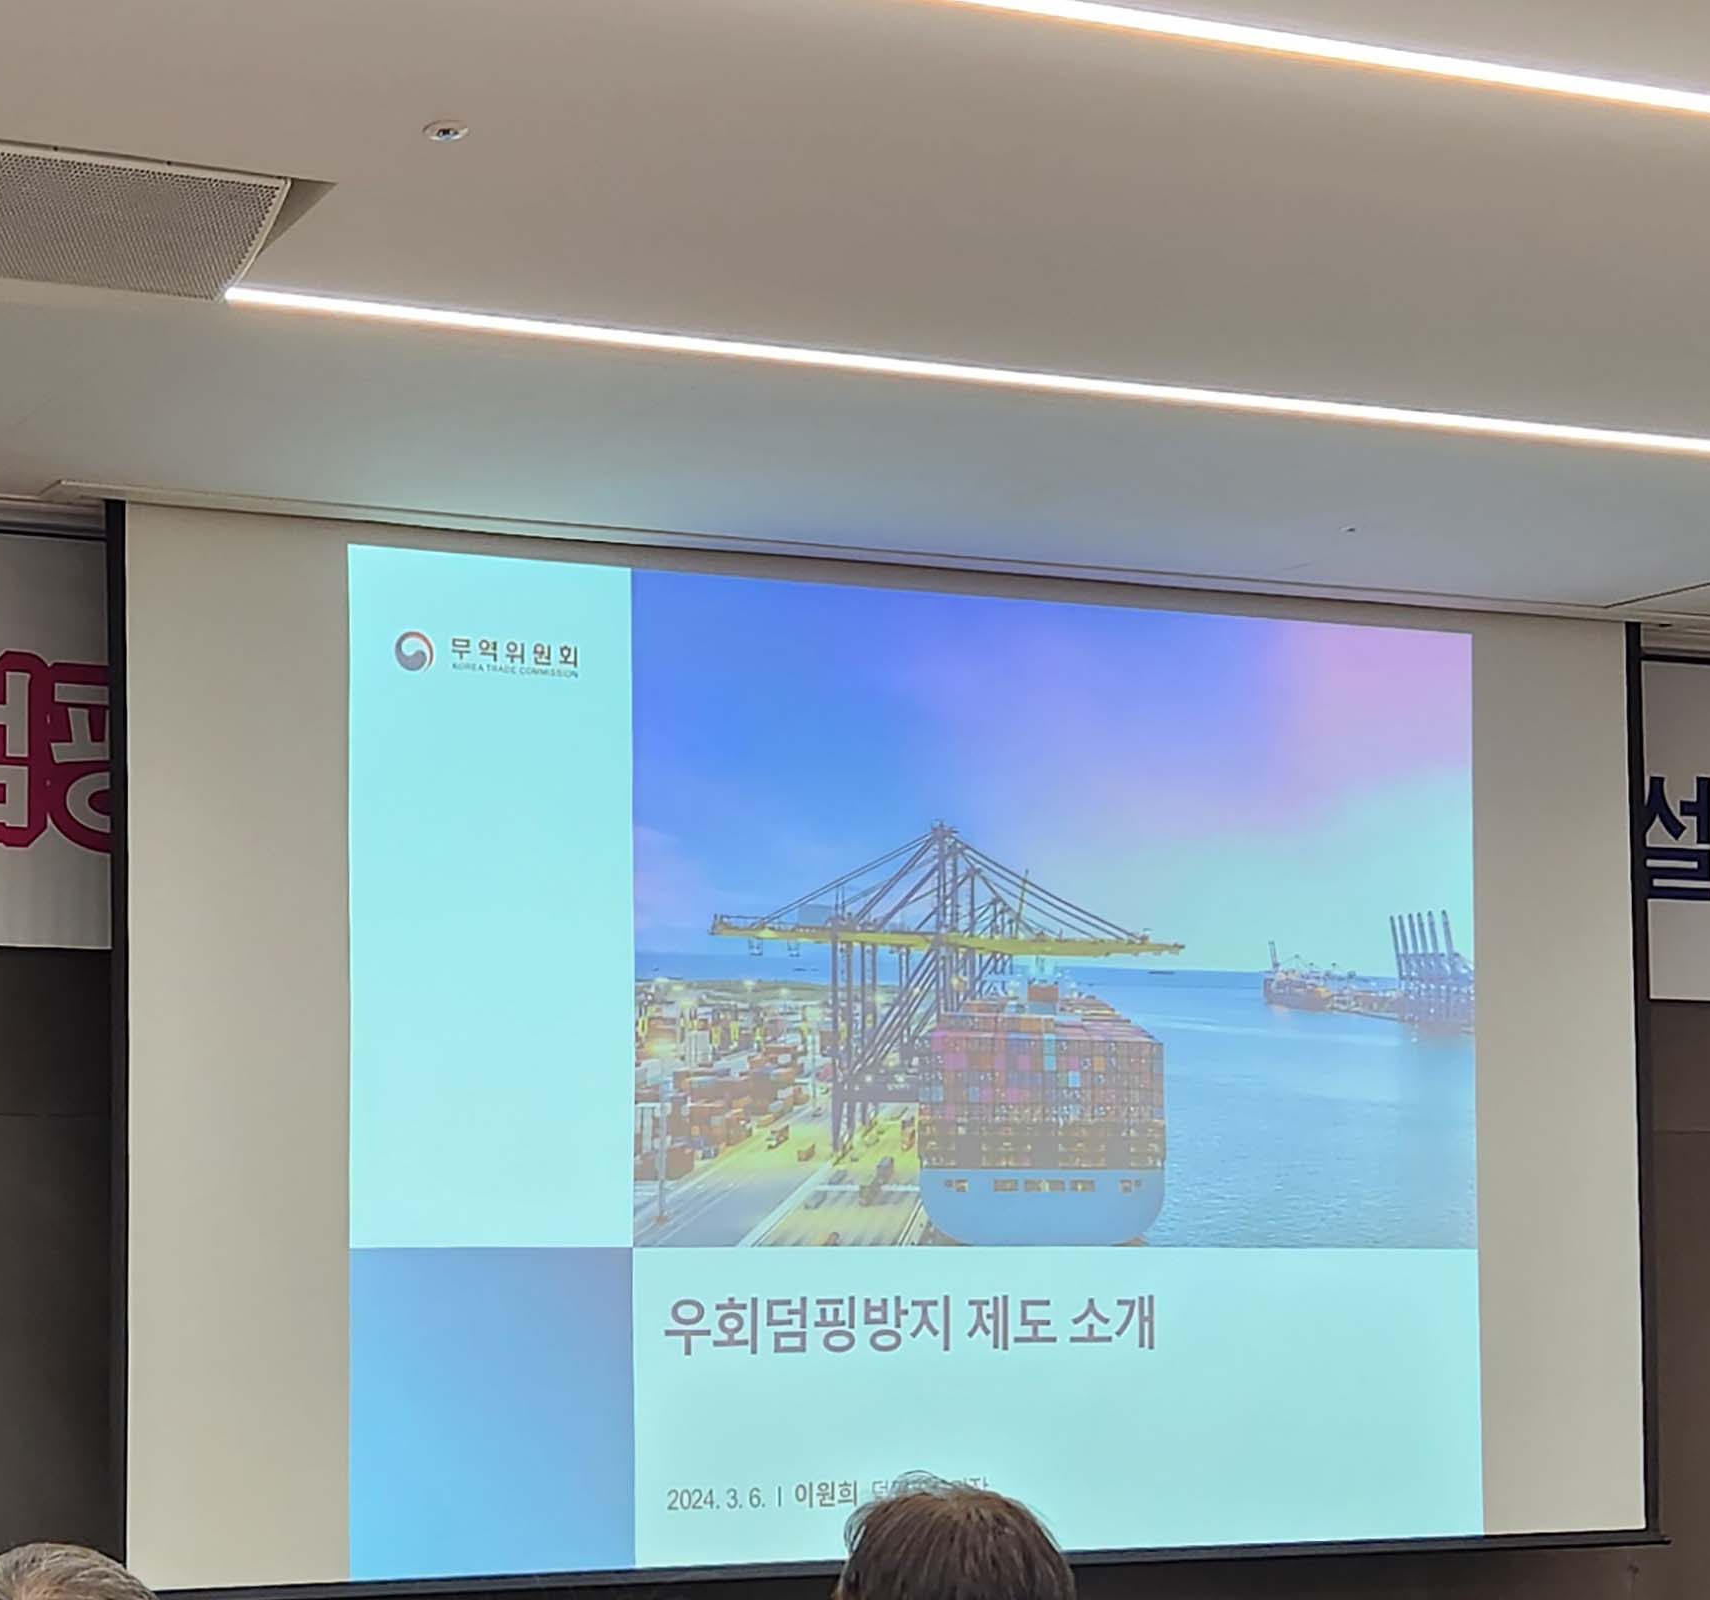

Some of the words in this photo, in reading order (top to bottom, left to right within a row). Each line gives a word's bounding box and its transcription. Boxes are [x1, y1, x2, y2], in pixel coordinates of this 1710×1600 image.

[451, 638, 579, 668] 무역위원회
[664, 1295, 951, 1356] 우회덤핑방지
[967, 1295, 1057, 1352] 제도
[1069, 1295, 1157, 1351] 소개
[795, 1480, 858, 1509] 이원희
